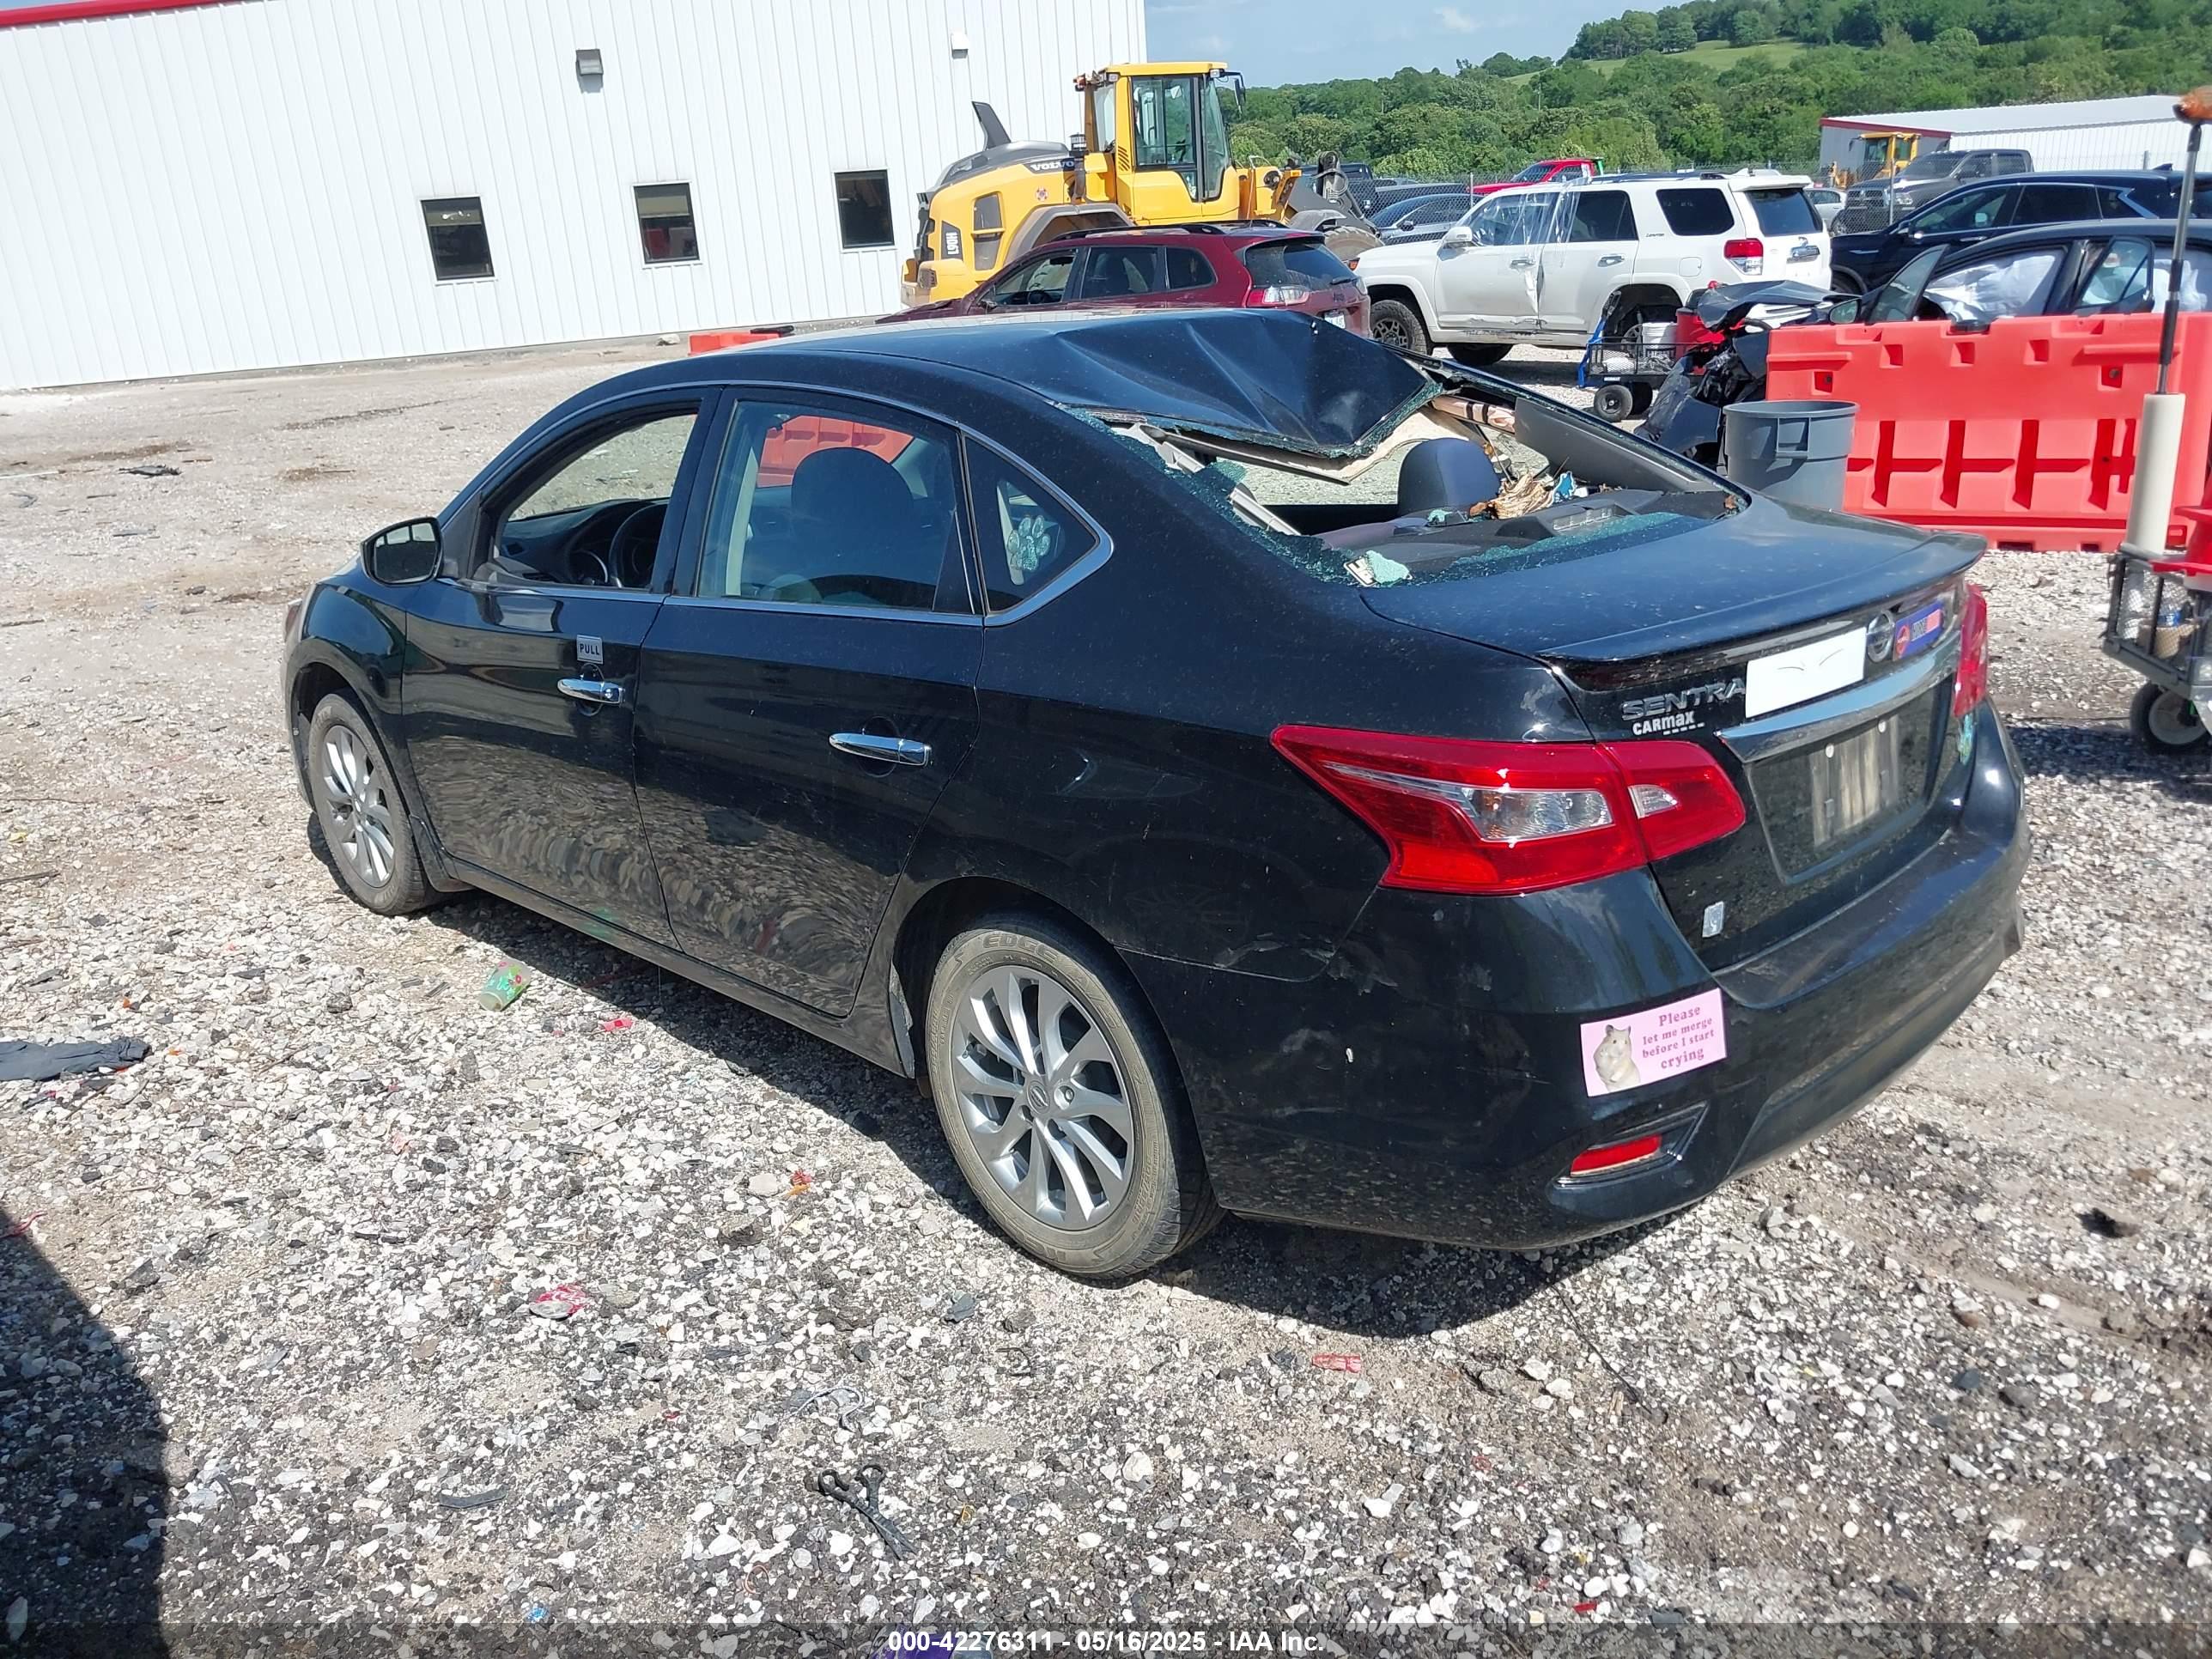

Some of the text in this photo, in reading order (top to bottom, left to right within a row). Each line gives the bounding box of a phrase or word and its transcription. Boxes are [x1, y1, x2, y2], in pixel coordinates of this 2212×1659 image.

[1030, 161, 1074, 171] VOLVO
[580, 643, 599, 655] PULL
[1621, 678, 1746, 720] SENTRA
[982, 933, 1058, 963] EDGE
[1659, 1006, 1700, 1026] Please
[1643, 1017, 1713, 1045] let me merge
[1642, 1042, 1679, 1059] before
[1689, 1029, 1715, 1044] start
[1660, 1048, 1705, 1068] crying
